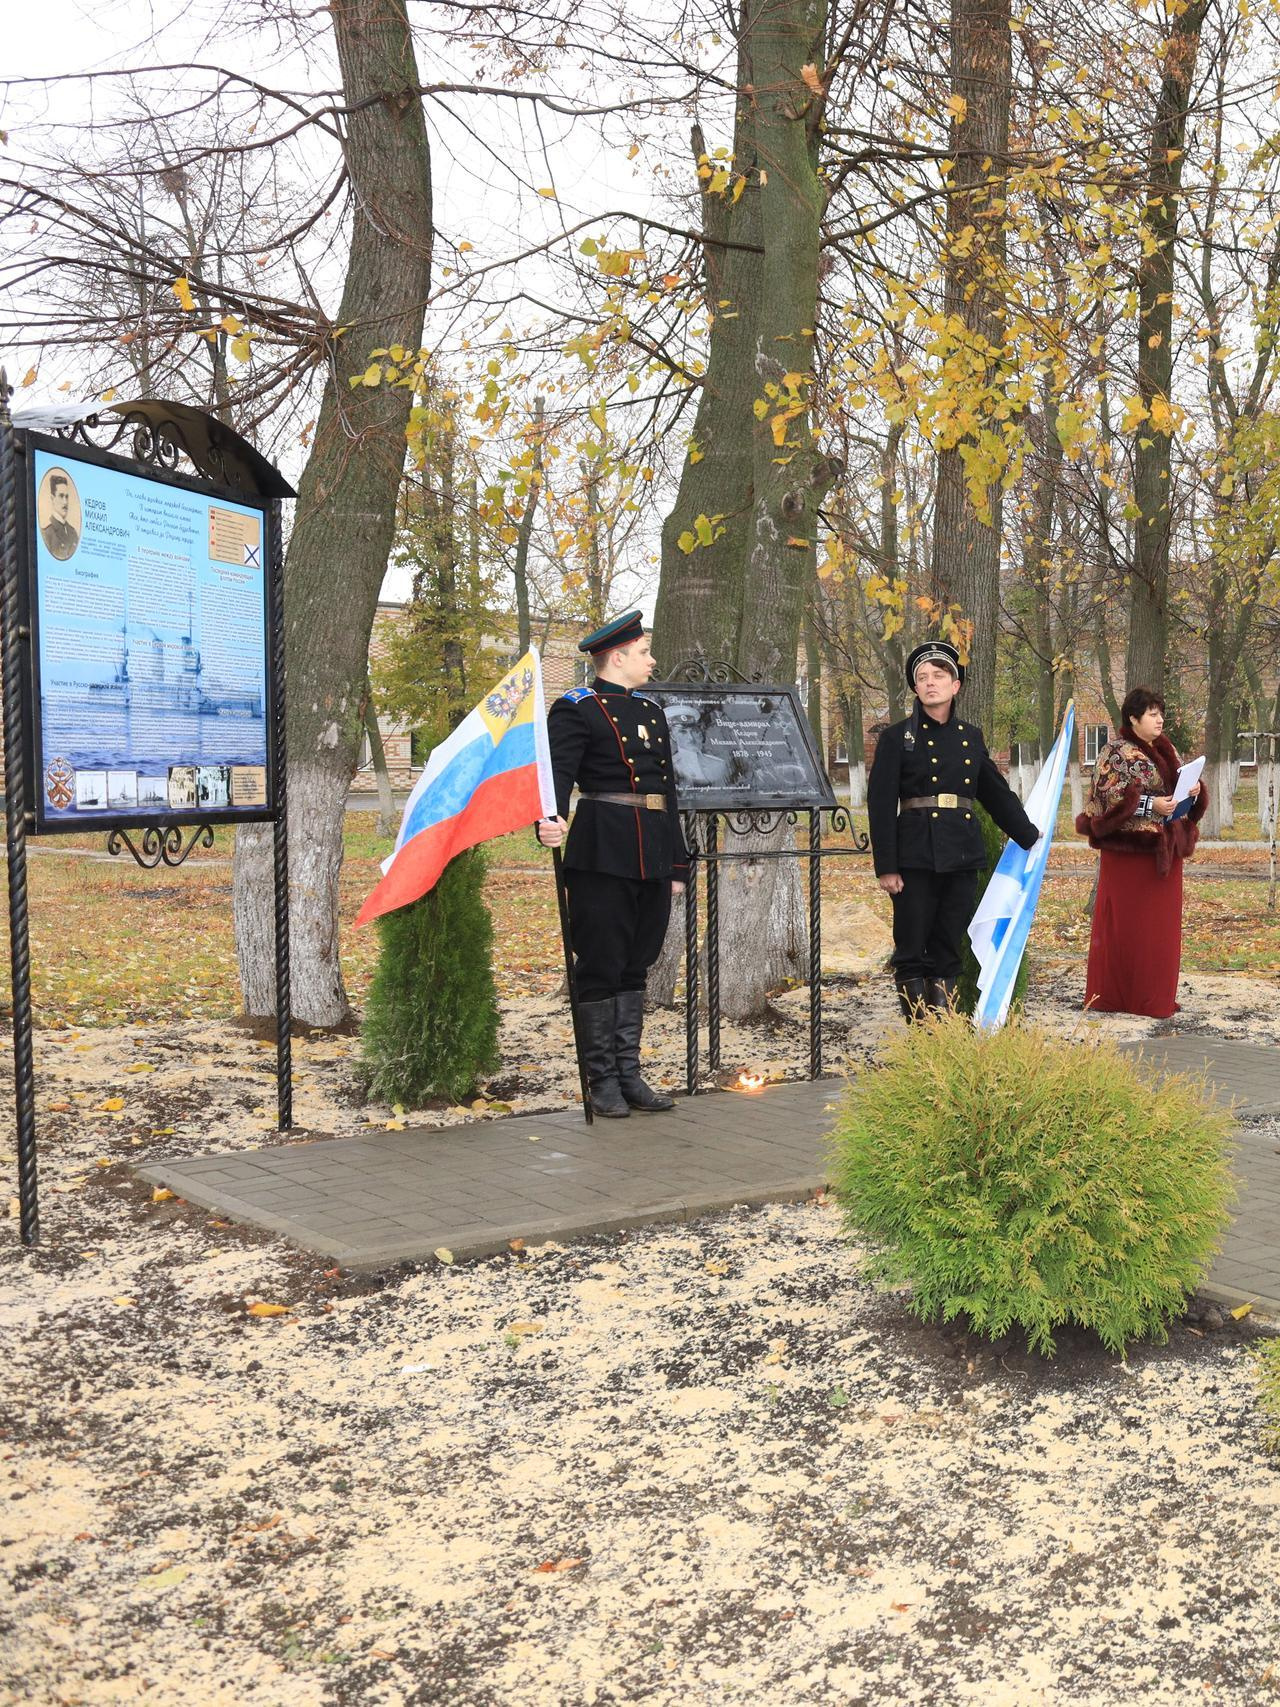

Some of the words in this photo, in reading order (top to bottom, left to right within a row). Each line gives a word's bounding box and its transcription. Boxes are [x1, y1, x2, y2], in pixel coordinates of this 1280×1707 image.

[85, 499, 106, 511] КЕДРОВ
[85, 510, 107, 522] МИХАИЛ
[85, 521, 130, 539] АЛЕКСАНДРОВИЧ
[716, 719, 771, 728] Вице-адмирал
[710, 738, 737, 746] Михаил
[733, 750, 749, 758] 1878
[756, 750, 773, 758] 1945
